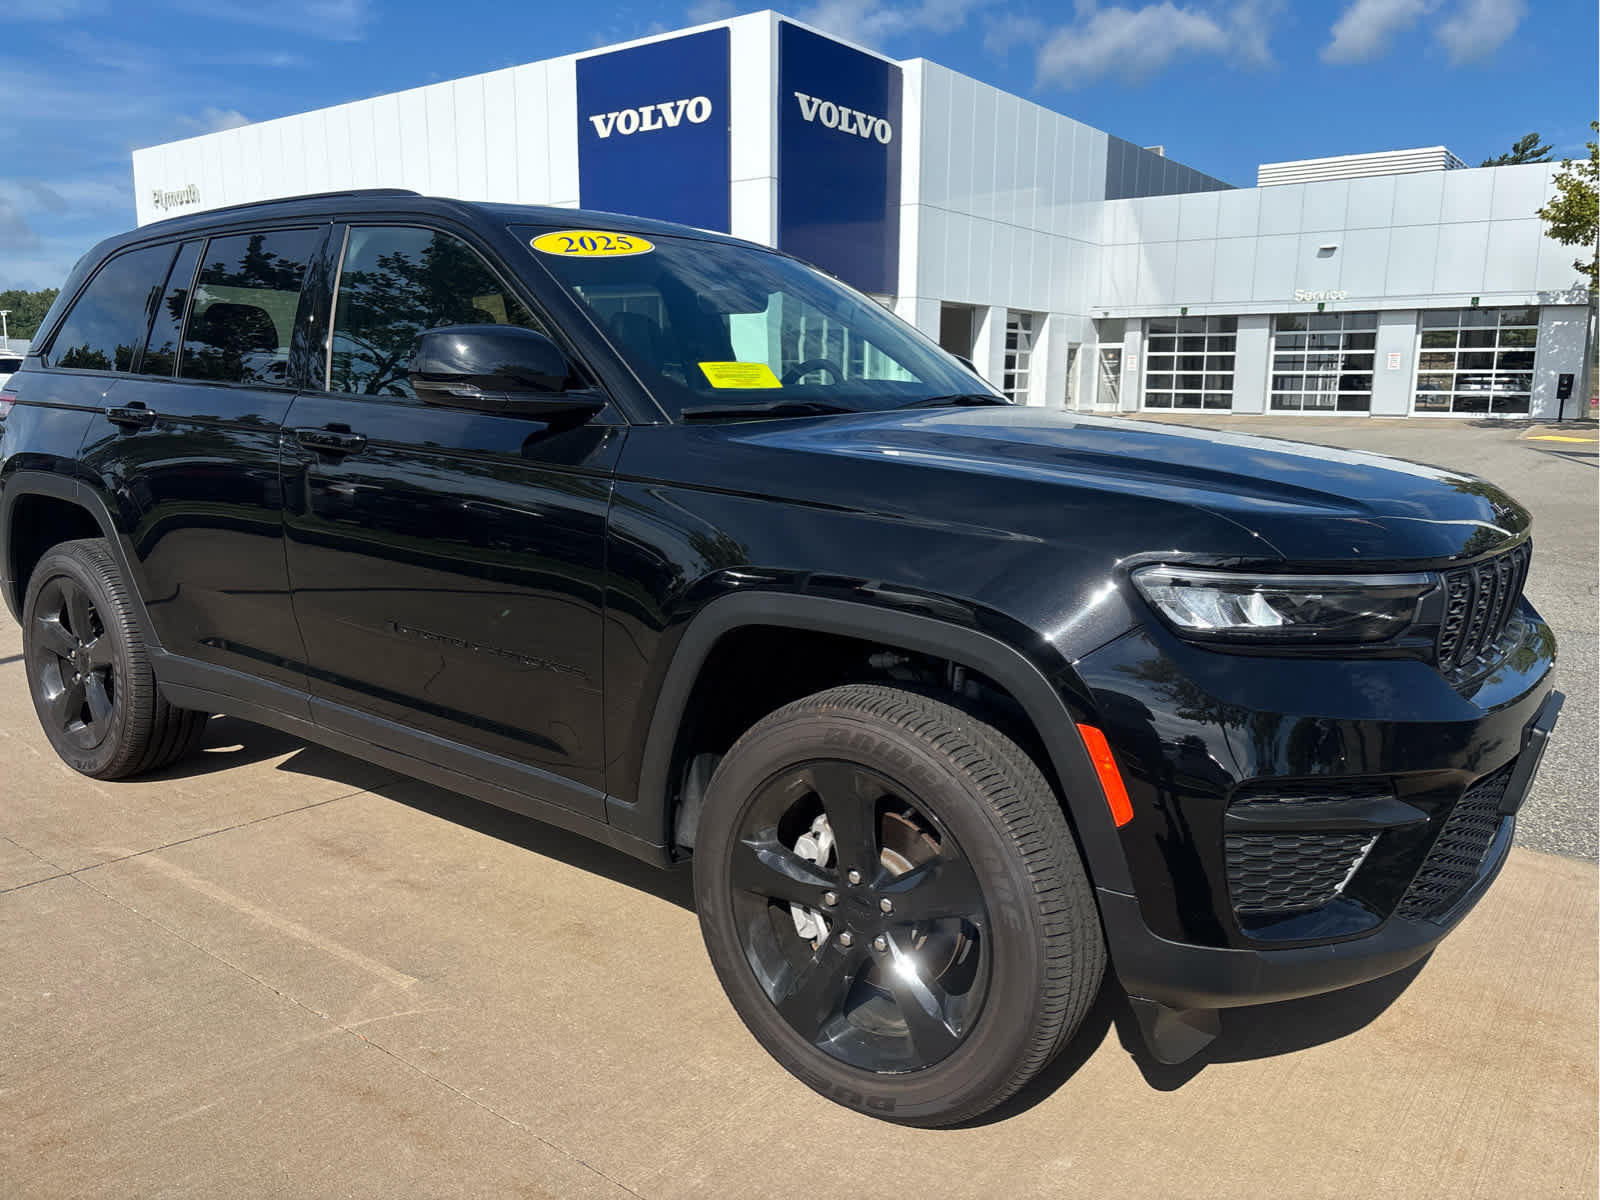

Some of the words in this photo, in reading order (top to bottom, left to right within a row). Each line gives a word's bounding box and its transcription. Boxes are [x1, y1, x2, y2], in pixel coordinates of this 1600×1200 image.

[589, 96, 712, 138] VOLVO
[794, 91, 892, 144] VOLVO
[152, 184, 200, 210] Plymouth
[558, 236, 633, 252] 2025
[1295, 289, 1347, 301] Service
